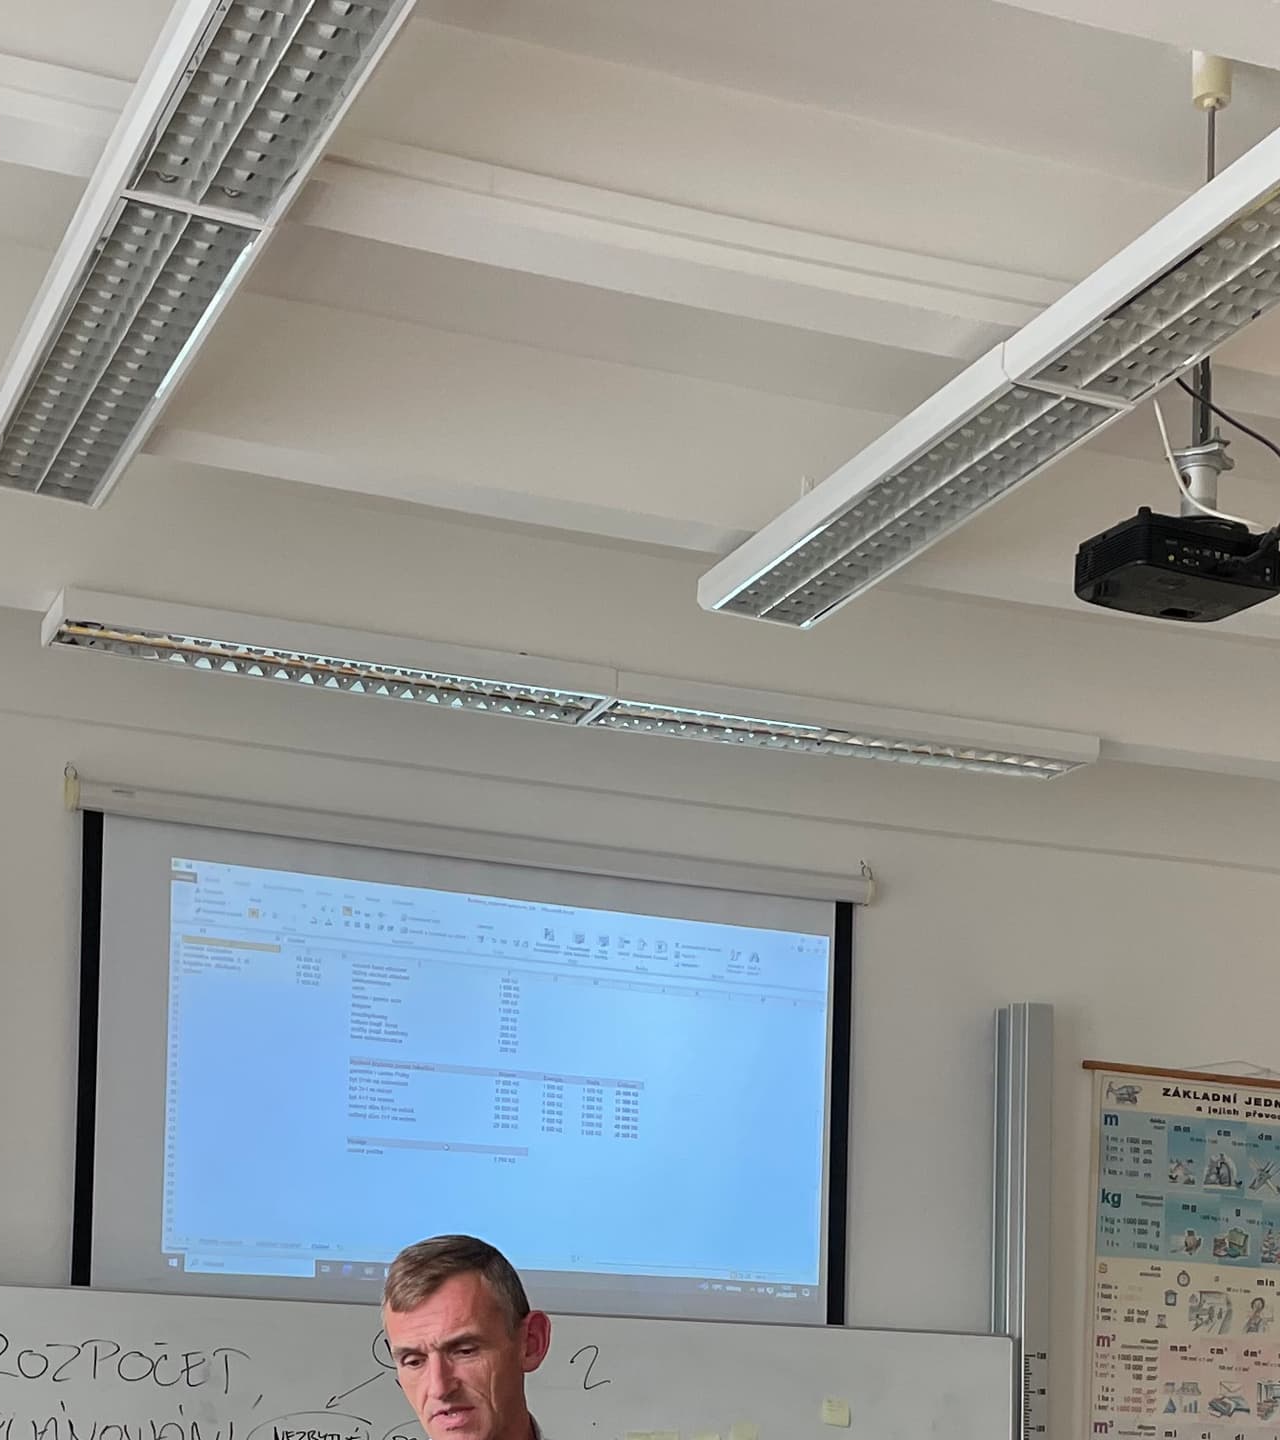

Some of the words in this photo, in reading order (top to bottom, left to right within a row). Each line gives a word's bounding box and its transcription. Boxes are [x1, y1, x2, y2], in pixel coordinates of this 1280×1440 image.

[1162, 1086, 1237, 1104] ZÁKLADNÍ
[1208, 1105, 1239, 1116] jejich
[1104, 1113, 1119, 1126] m
[1101, 1187, 1121, 1208] kg
[1257, 1279, 1275, 1287] min
